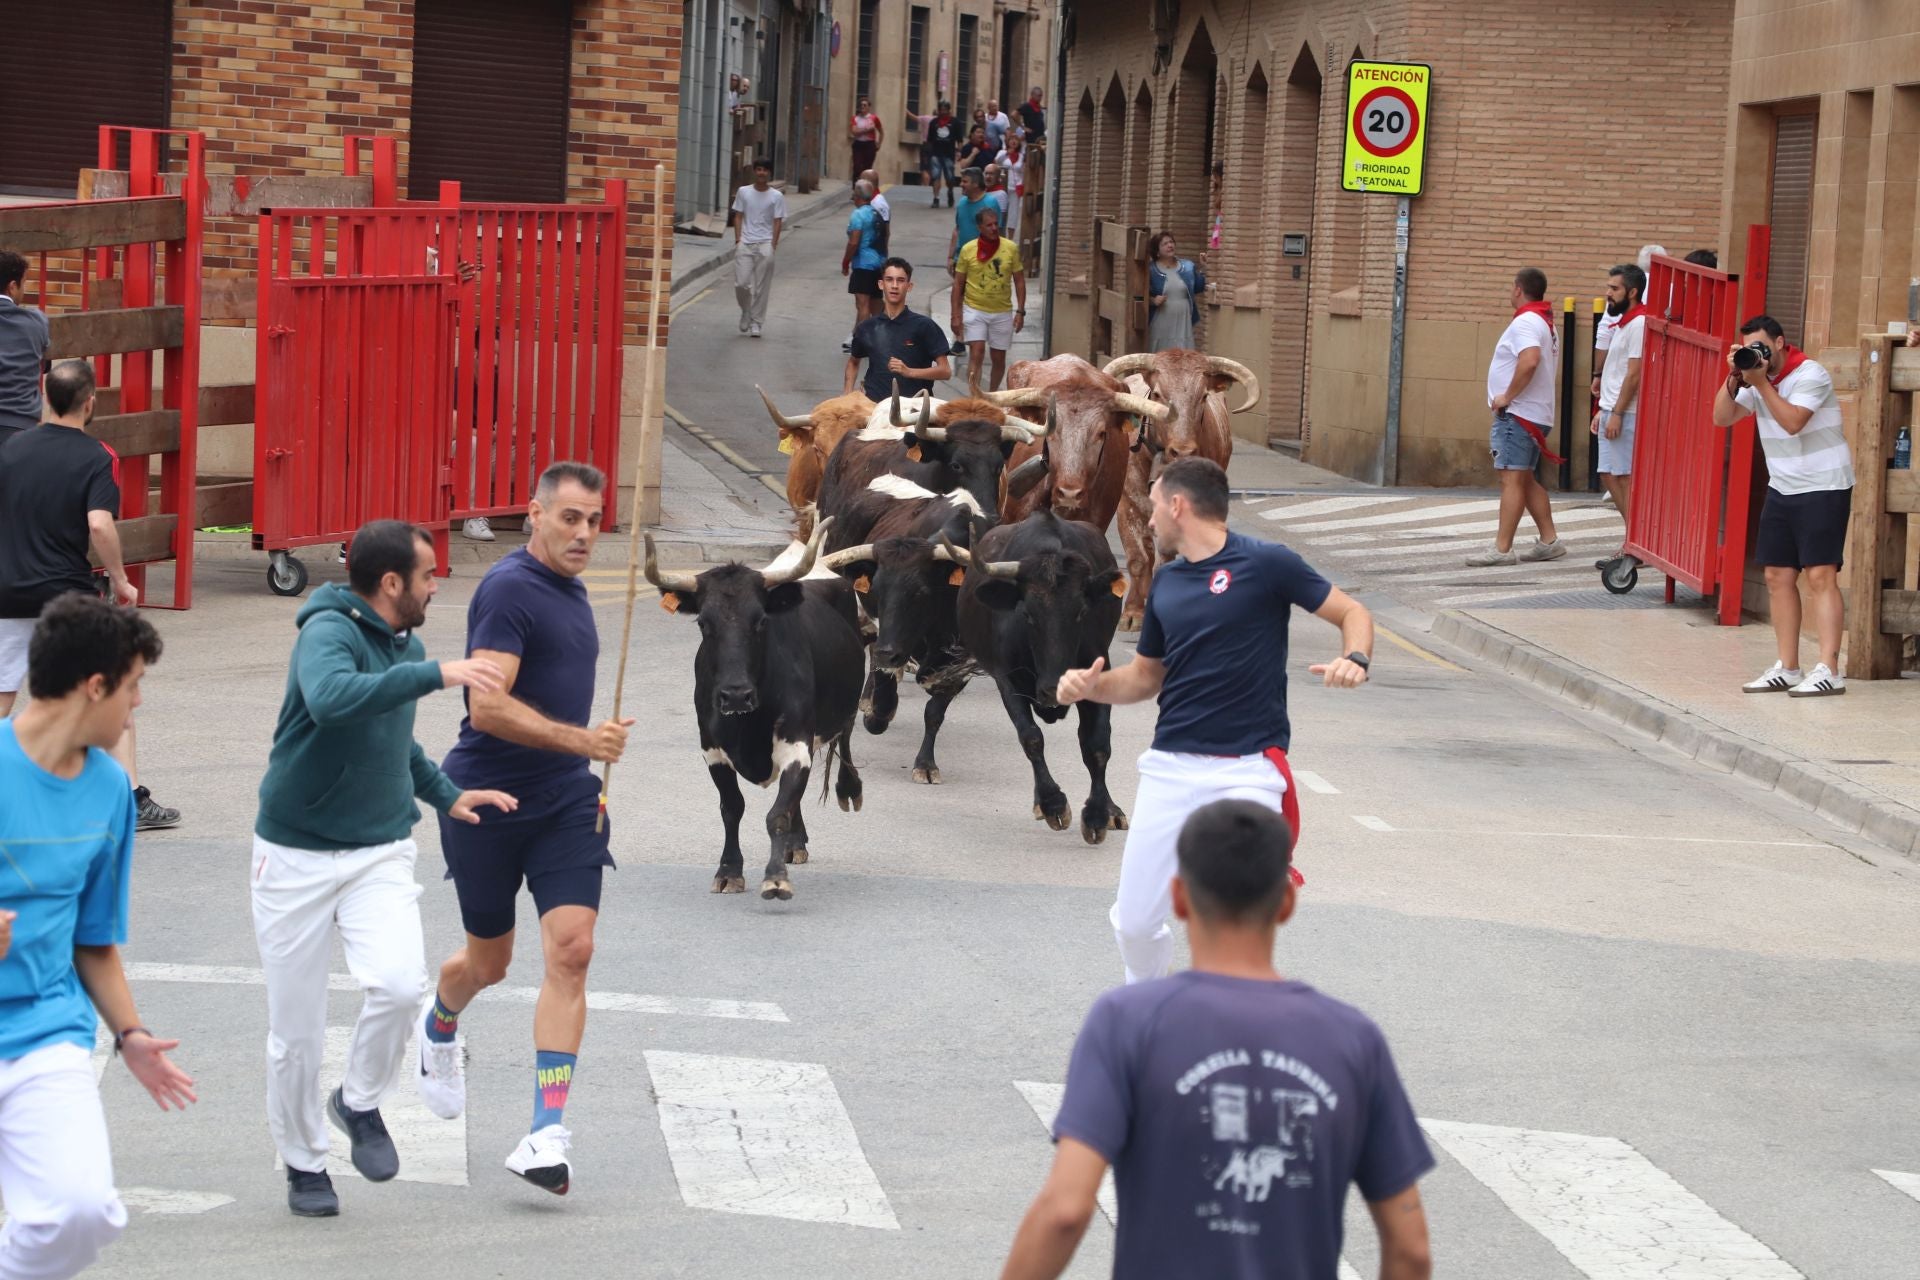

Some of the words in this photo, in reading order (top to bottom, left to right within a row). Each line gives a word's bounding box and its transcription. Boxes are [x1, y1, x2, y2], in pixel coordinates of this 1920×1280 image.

[1355, 69, 1424, 83] ATENCIÓN
[1368, 109, 1405, 134] 20
[1355, 162, 1410, 175] PRIORIDAD
[1356, 176, 1408, 188] PEATONAL
